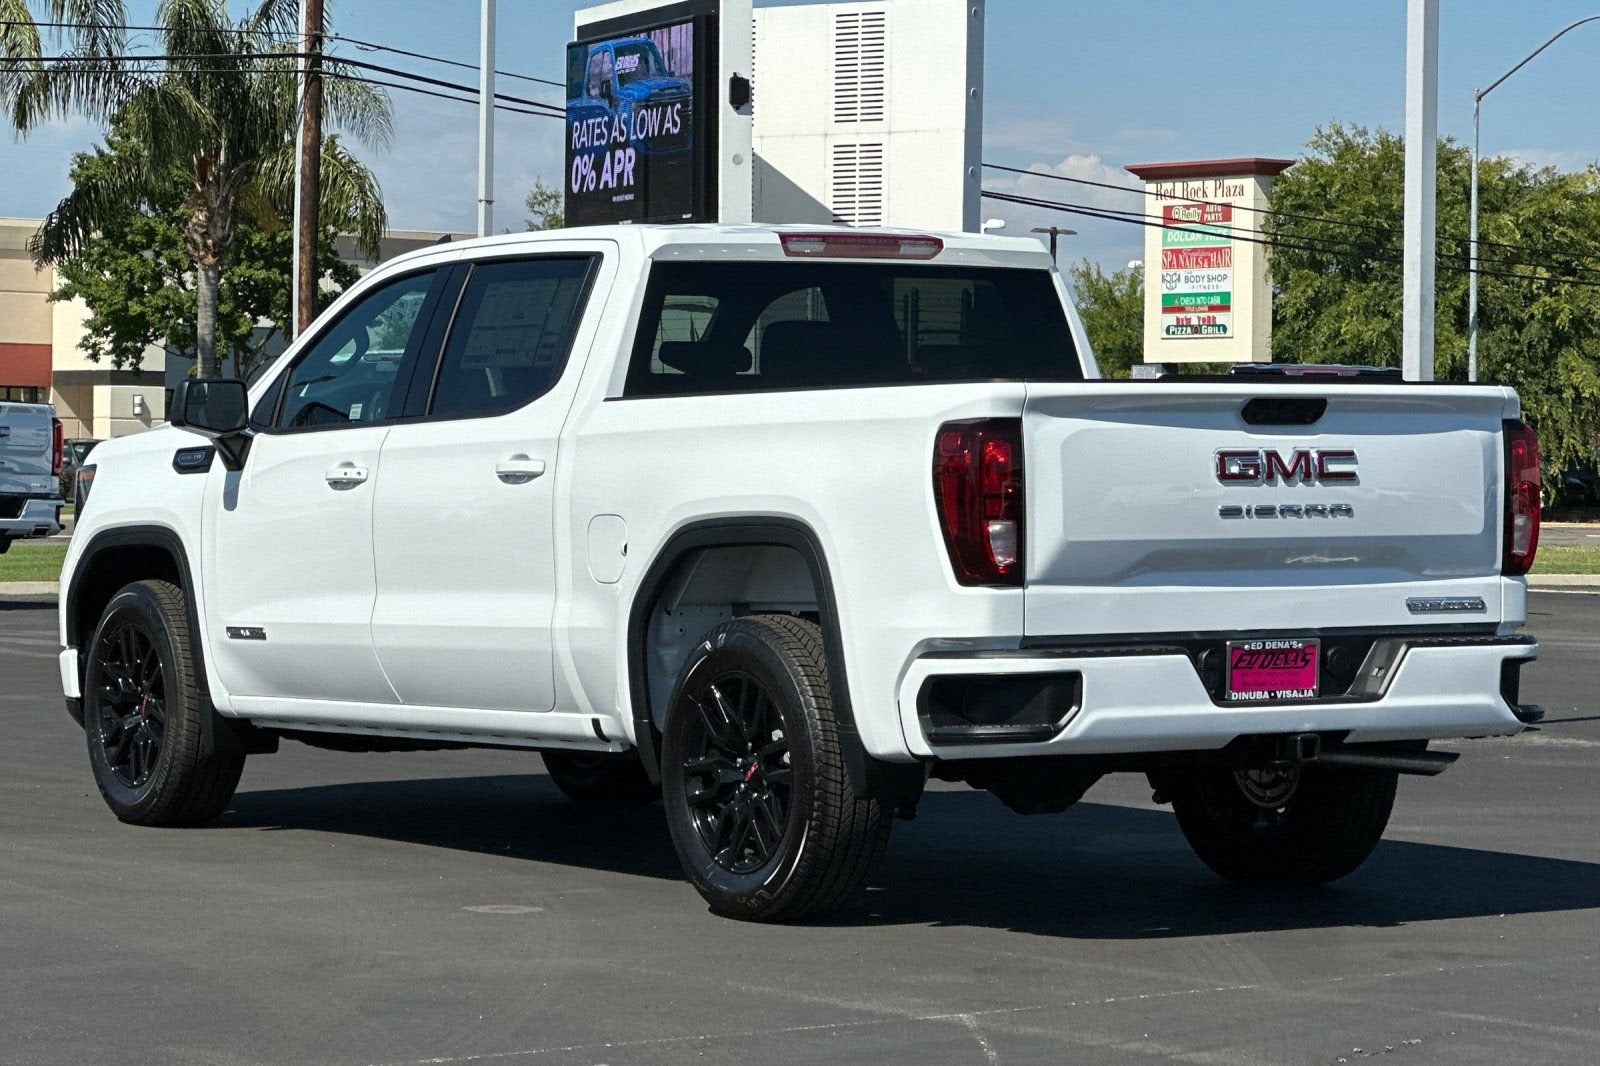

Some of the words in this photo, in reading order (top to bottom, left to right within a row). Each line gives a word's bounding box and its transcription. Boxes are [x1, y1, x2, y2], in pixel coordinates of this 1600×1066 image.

[572, 116, 608, 149] RATES
[610, 114, 627, 144] AS
[630, 107, 662, 140] LOW
[662, 103, 681, 135] AS
[572, 153, 596, 194] 0%
[600, 147, 635, 190] APR
[1156, 182, 1175, 200] Red
[1182, 180, 1208, 199] Rock
[1214, 179, 1244, 198] Plaza
[1206, 204, 1221, 213] AUTO
[1204, 213, 1222, 221] PARTS
[1162, 250, 1177, 269] SPA
[1178, 252, 1203, 269] NAILS
[1210, 249, 1232, 267] HAIR
[1184, 275, 1205, 283] BODY
[1206, 274, 1228, 283] SHOP
[1175, 316, 1192, 325] NEW
[1197, 315, 1217, 325] YORK
[1169, 325, 1192, 335] PIZZA
[1201, 325, 1225, 335] GRILL
[1214, 448, 1359, 486] GMC
[1218, 504, 1354, 519] SIERRA
[1251, 642, 1263, 650] ED
[1265, 641, 1299, 650] DENA'S
[1231, 691, 1270, 700] DINUBA
[1275, 689, 1314, 699] VISALIA
